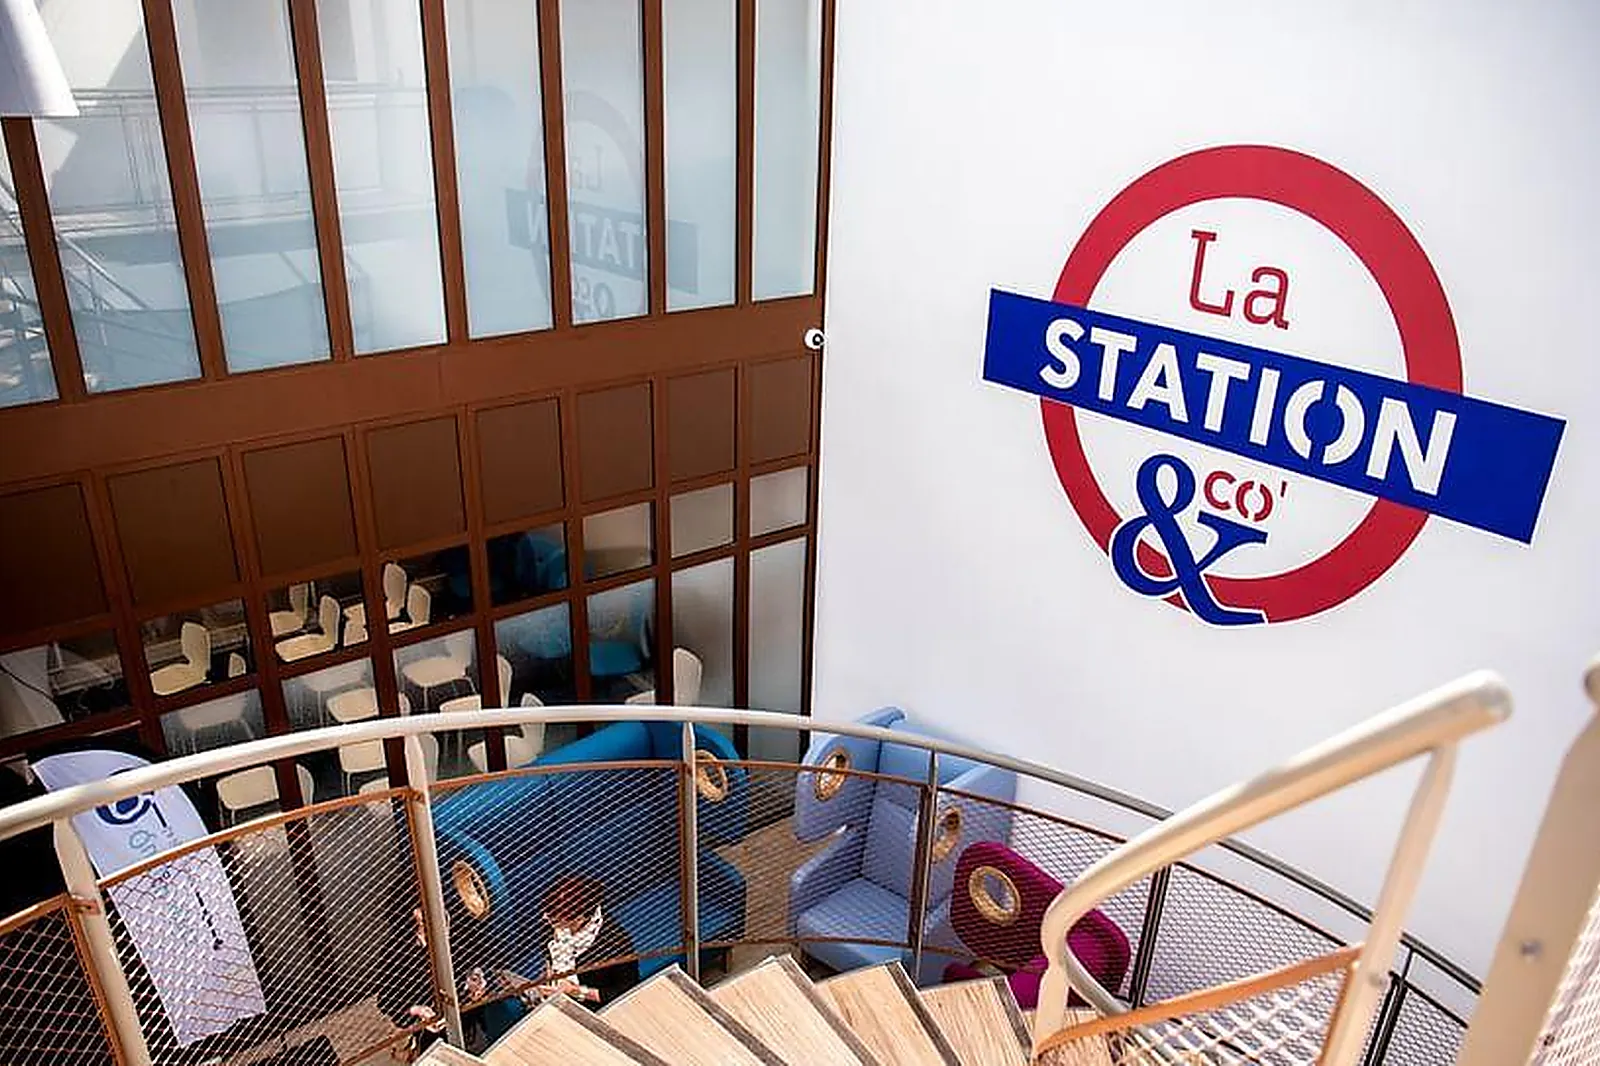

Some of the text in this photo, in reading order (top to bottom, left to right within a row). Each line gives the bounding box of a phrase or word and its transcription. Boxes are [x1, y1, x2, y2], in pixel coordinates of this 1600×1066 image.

[1189, 230, 1289, 330] La
[1040, 318, 1457, 496] STATION
[1111, 453, 1268, 625] &
